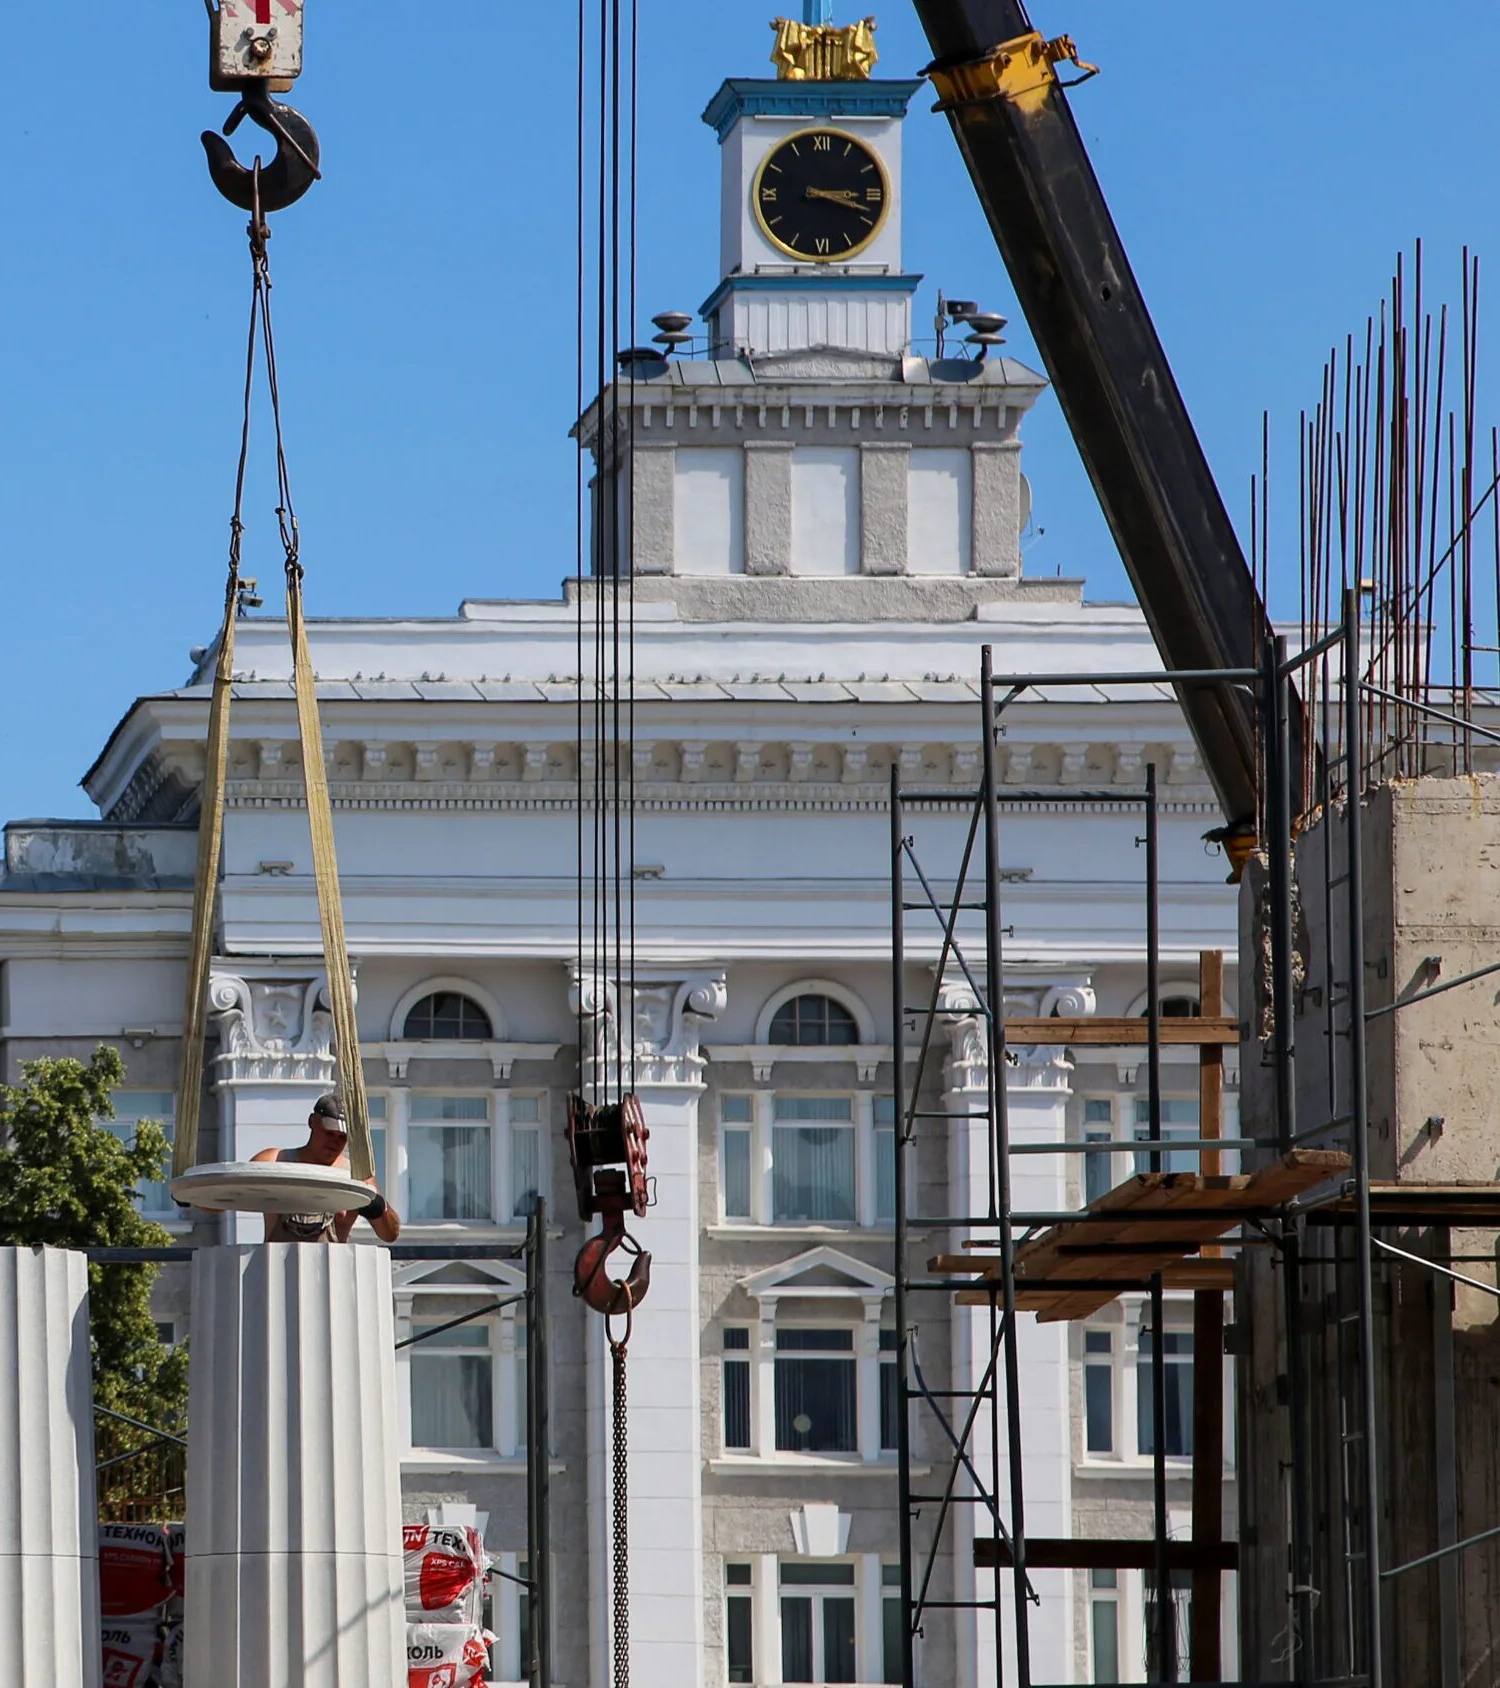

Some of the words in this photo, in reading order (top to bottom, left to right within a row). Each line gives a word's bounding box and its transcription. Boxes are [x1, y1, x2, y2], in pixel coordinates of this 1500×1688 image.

[813, 136, 830, 151] XII
[762, 187, 777, 200] IX
[866, 188, 881, 200] III
[815, 238, 829, 253] VI
[432, 1530, 466, 1552] ТЕХ
[431, 1558, 448, 1567] XPS
